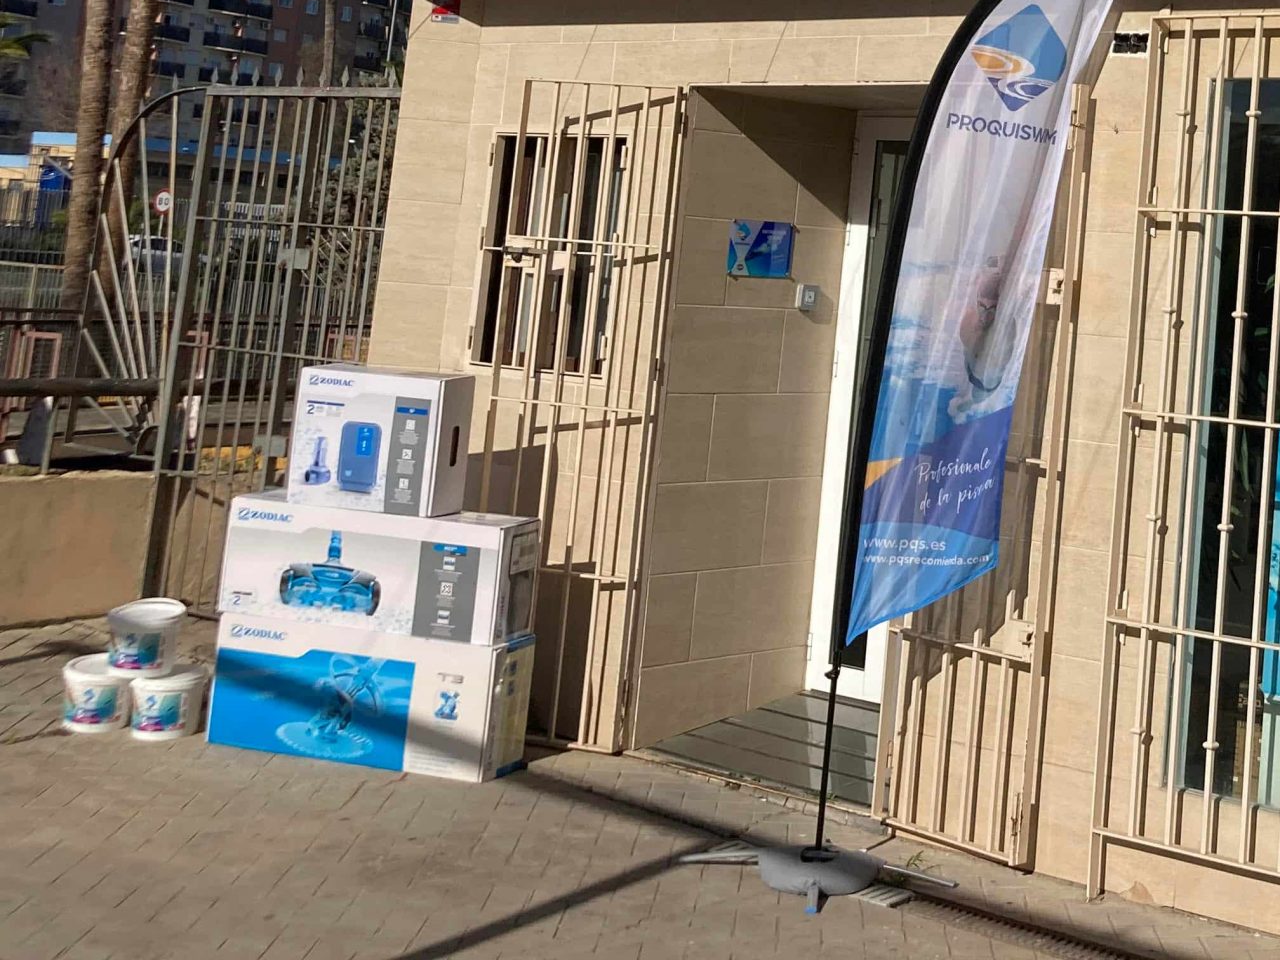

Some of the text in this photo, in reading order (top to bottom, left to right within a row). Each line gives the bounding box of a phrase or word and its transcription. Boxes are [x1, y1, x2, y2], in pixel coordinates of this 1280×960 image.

[319, 376, 354, 387] ZODIAC
[250, 509, 294, 523] ZODIAC
[243, 626, 287, 641] ZODIAC
